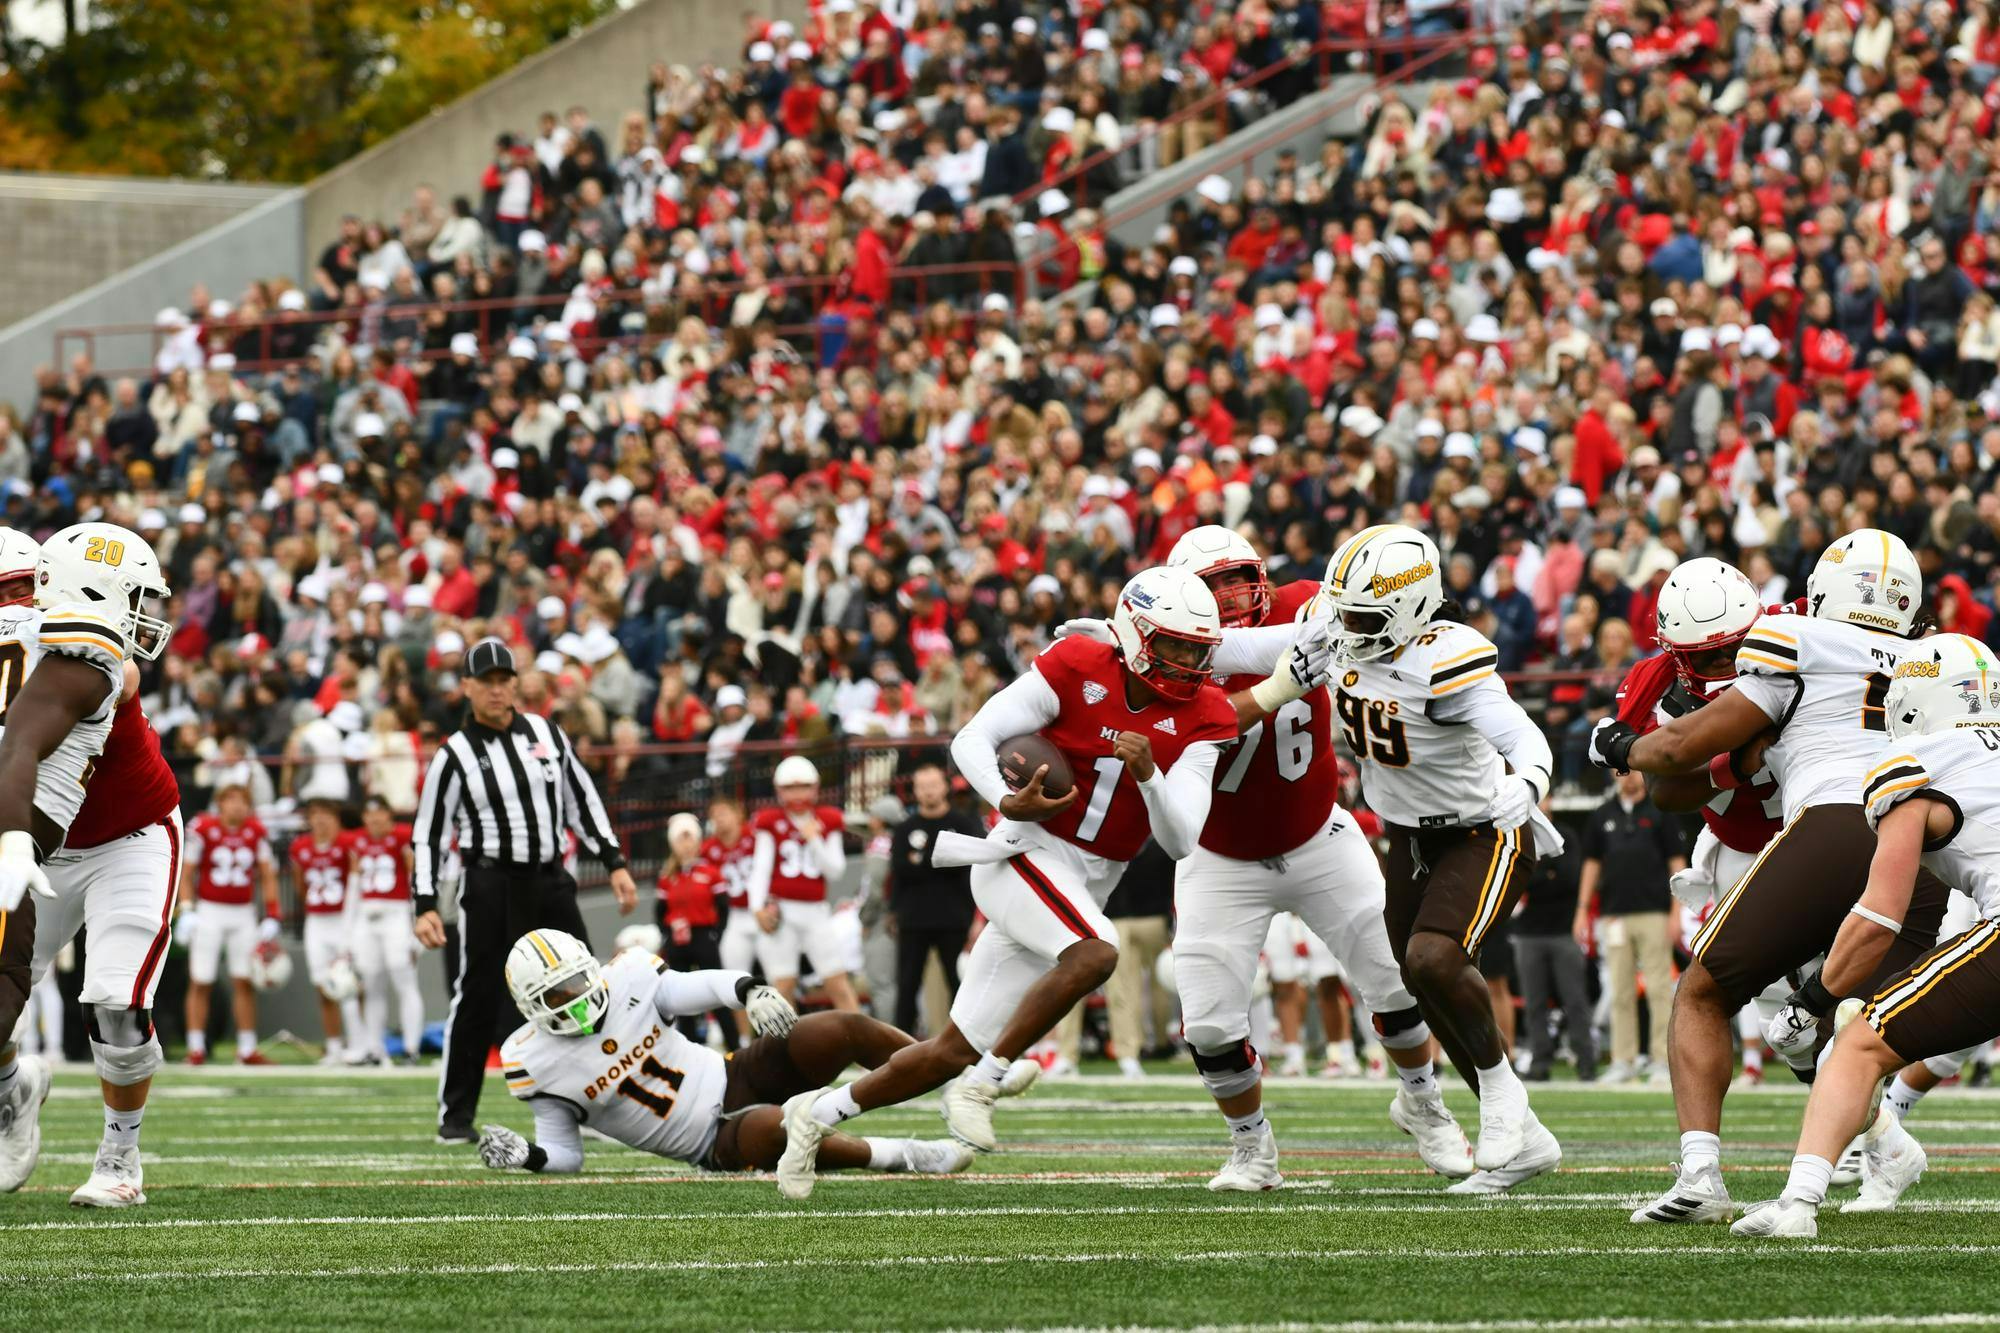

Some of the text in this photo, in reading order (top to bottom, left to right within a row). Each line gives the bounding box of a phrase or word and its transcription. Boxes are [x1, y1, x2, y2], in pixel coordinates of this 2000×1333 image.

[85, 536, 125, 567] 20
[1371, 560, 1434, 599] Broncos
[1890, 578, 1901, 587] 91
[1848, 611, 1900, 630] BRONCOS
[1217, 690, 1314, 794] 76
[1336, 686, 1412, 769] 99
[1075, 755, 1125, 843] 1
[209, 846, 255, 887] 32
[305, 866, 345, 906] 25
[584, 1024, 661, 1100] BRONCOS
[617, 1055, 686, 1121] 11
